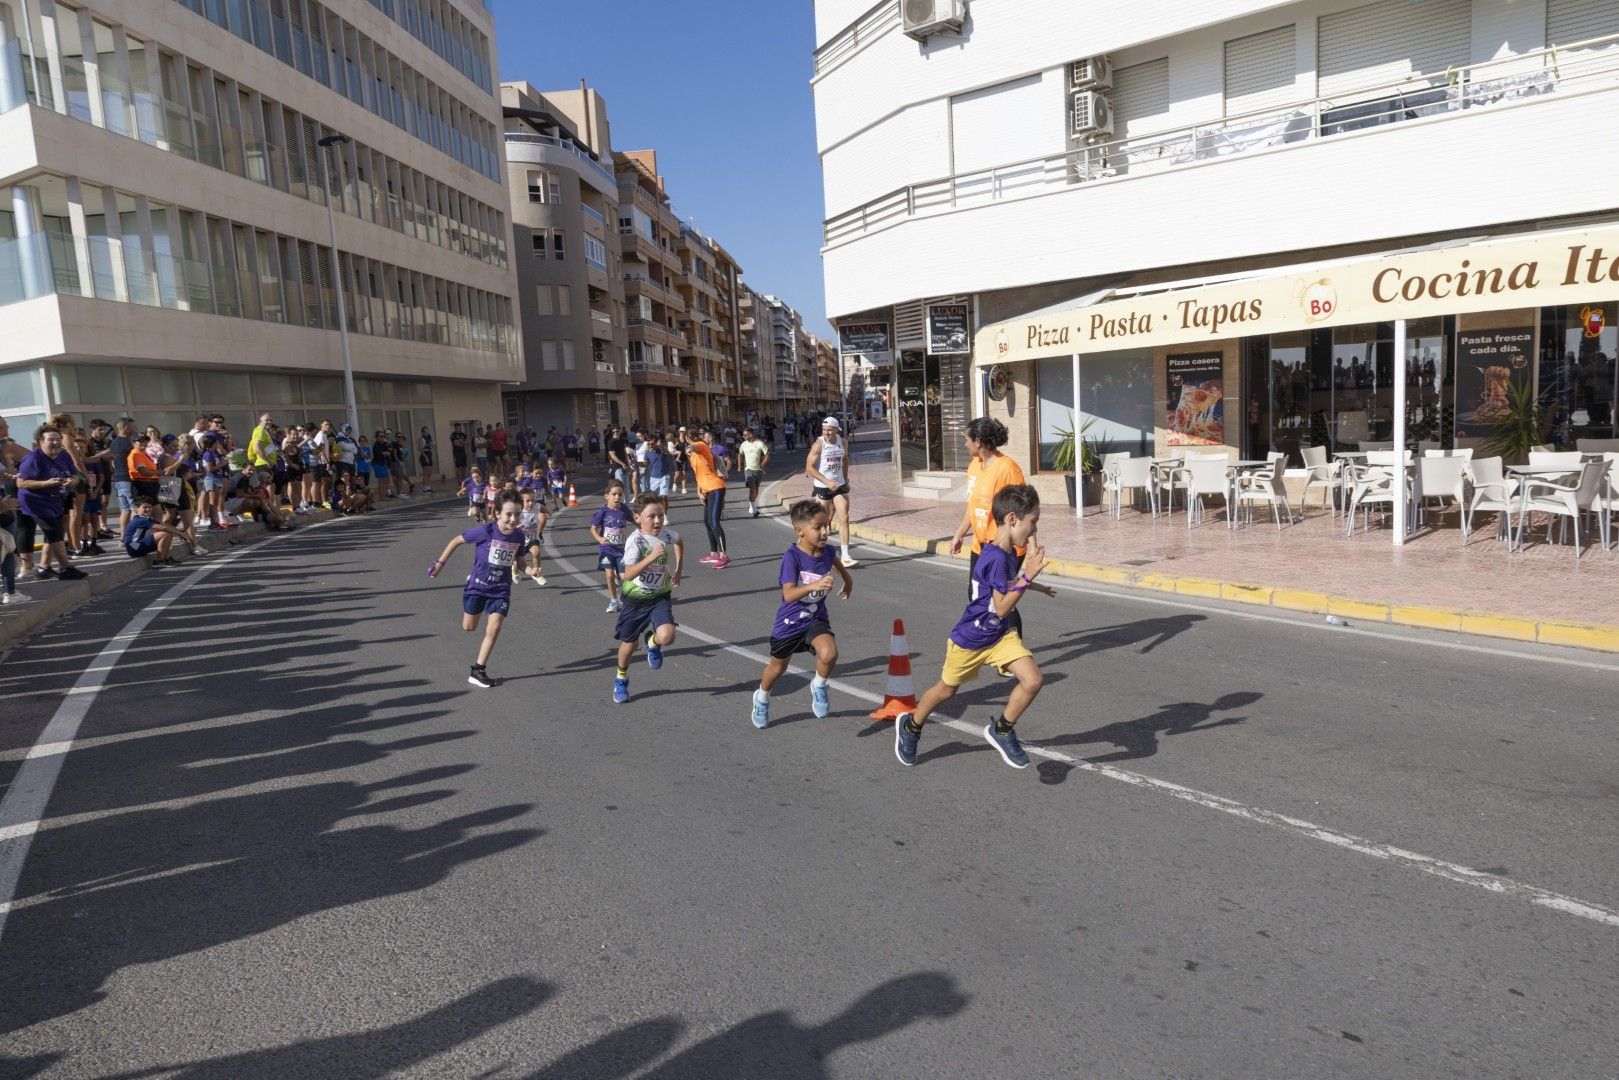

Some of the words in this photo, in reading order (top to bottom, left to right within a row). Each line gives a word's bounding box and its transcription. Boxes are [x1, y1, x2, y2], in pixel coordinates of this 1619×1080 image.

[1372, 259, 1540, 304] Cocina
[931, 306, 966, 317] LUXOR
[1027, 324, 1069, 348] Pizza
[1089, 311, 1152, 340] Pasta
[1177, 298, 1263, 335] Tapas
[1461, 336, 1492, 345] Pasta
[1494, 334, 1532, 343] fresca
[1470, 346, 1498, 355] cada
[1169, 359, 1190, 367] Pizza
[1191, 357, 1220, 366] casera
[493, 548, 514, 562] 505
[639, 571, 663, 585] 507
